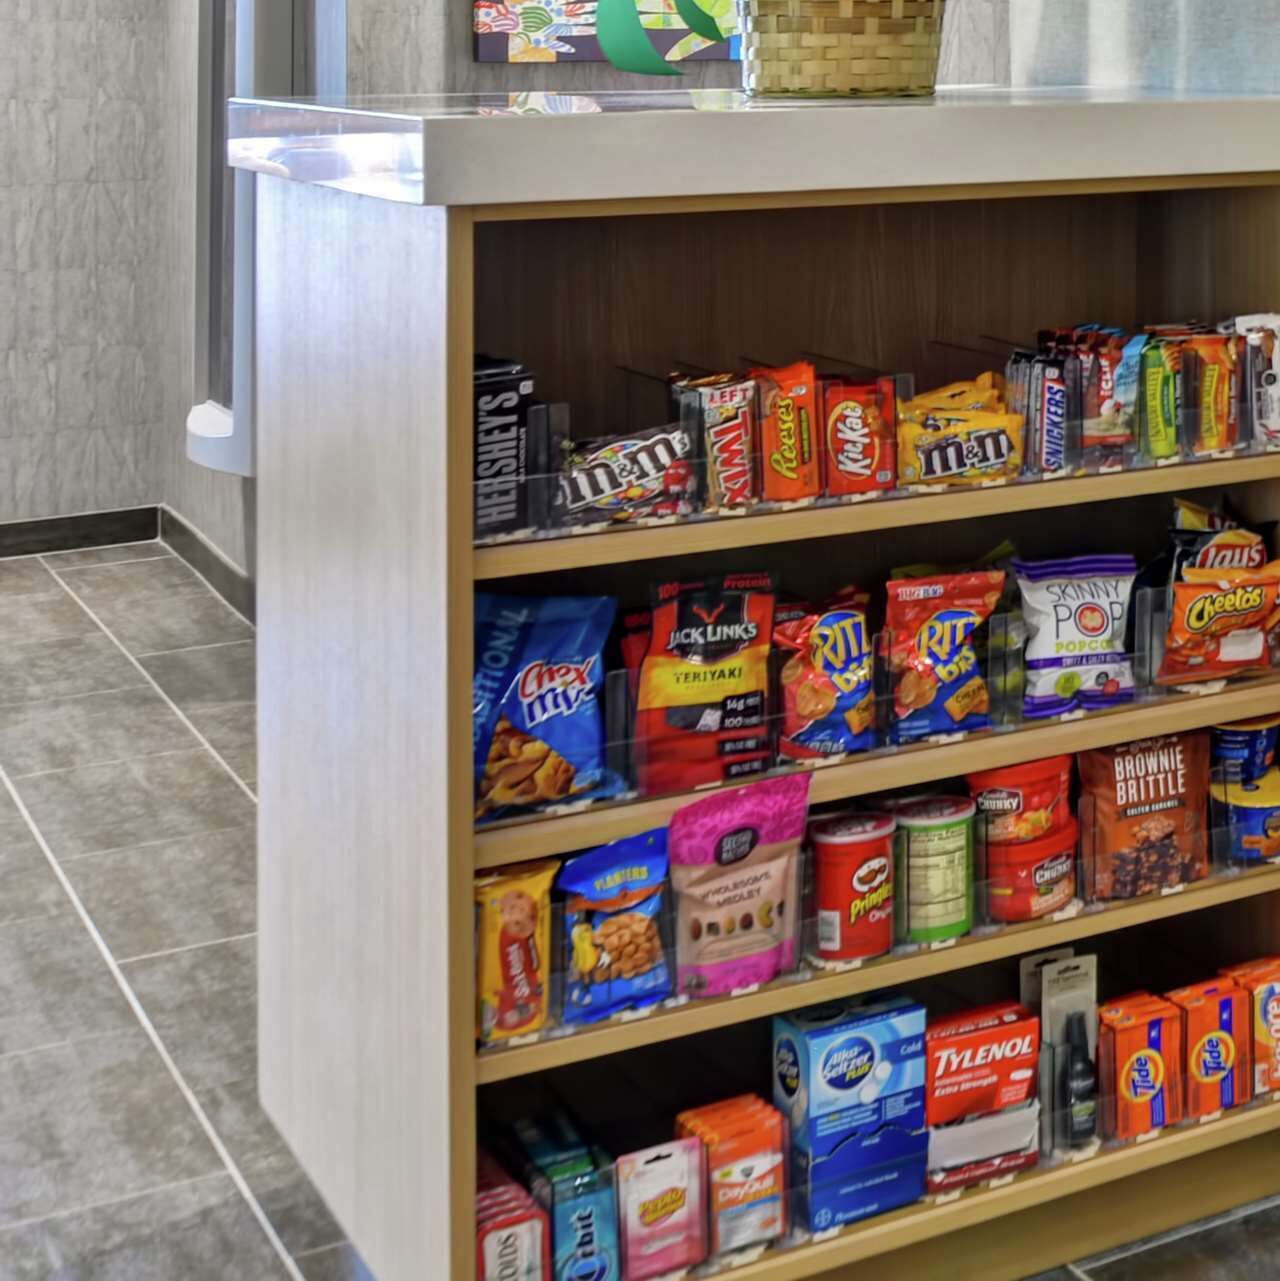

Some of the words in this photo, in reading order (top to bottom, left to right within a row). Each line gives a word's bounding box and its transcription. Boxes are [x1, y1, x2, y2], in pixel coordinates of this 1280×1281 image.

[708, 385, 752, 406] LEFT
[1044, 385, 1067, 471] SNICKERS
[476, 391, 519, 524] HERSHEY'S
[711, 408, 751, 507] TWIX
[1046, 579, 1120, 603] SKINNY
[1187, 586, 1265, 631] Cheetos
[666, 626, 705, 650] JACK
[919, 615, 985, 661] RIT
[1053, 600, 1124, 641] POP
[810, 614, 871, 672] RIT
[1055, 639, 1114, 654] POPCO
[518, 651, 599, 701] Chex
[673, 667, 743, 684] TERIYAKI
[1113, 745, 1185, 781] BROWNIE
[1116, 769, 1187, 806] BRITTLE
[850, 881, 893, 924] Pringle
[900, 1040, 923, 1056] Cold
[933, 1034, 1034, 1079] TYLENOL
[1201, 1038, 1227, 1077] Tide
[1131, 1055, 1156, 1098] Tide
